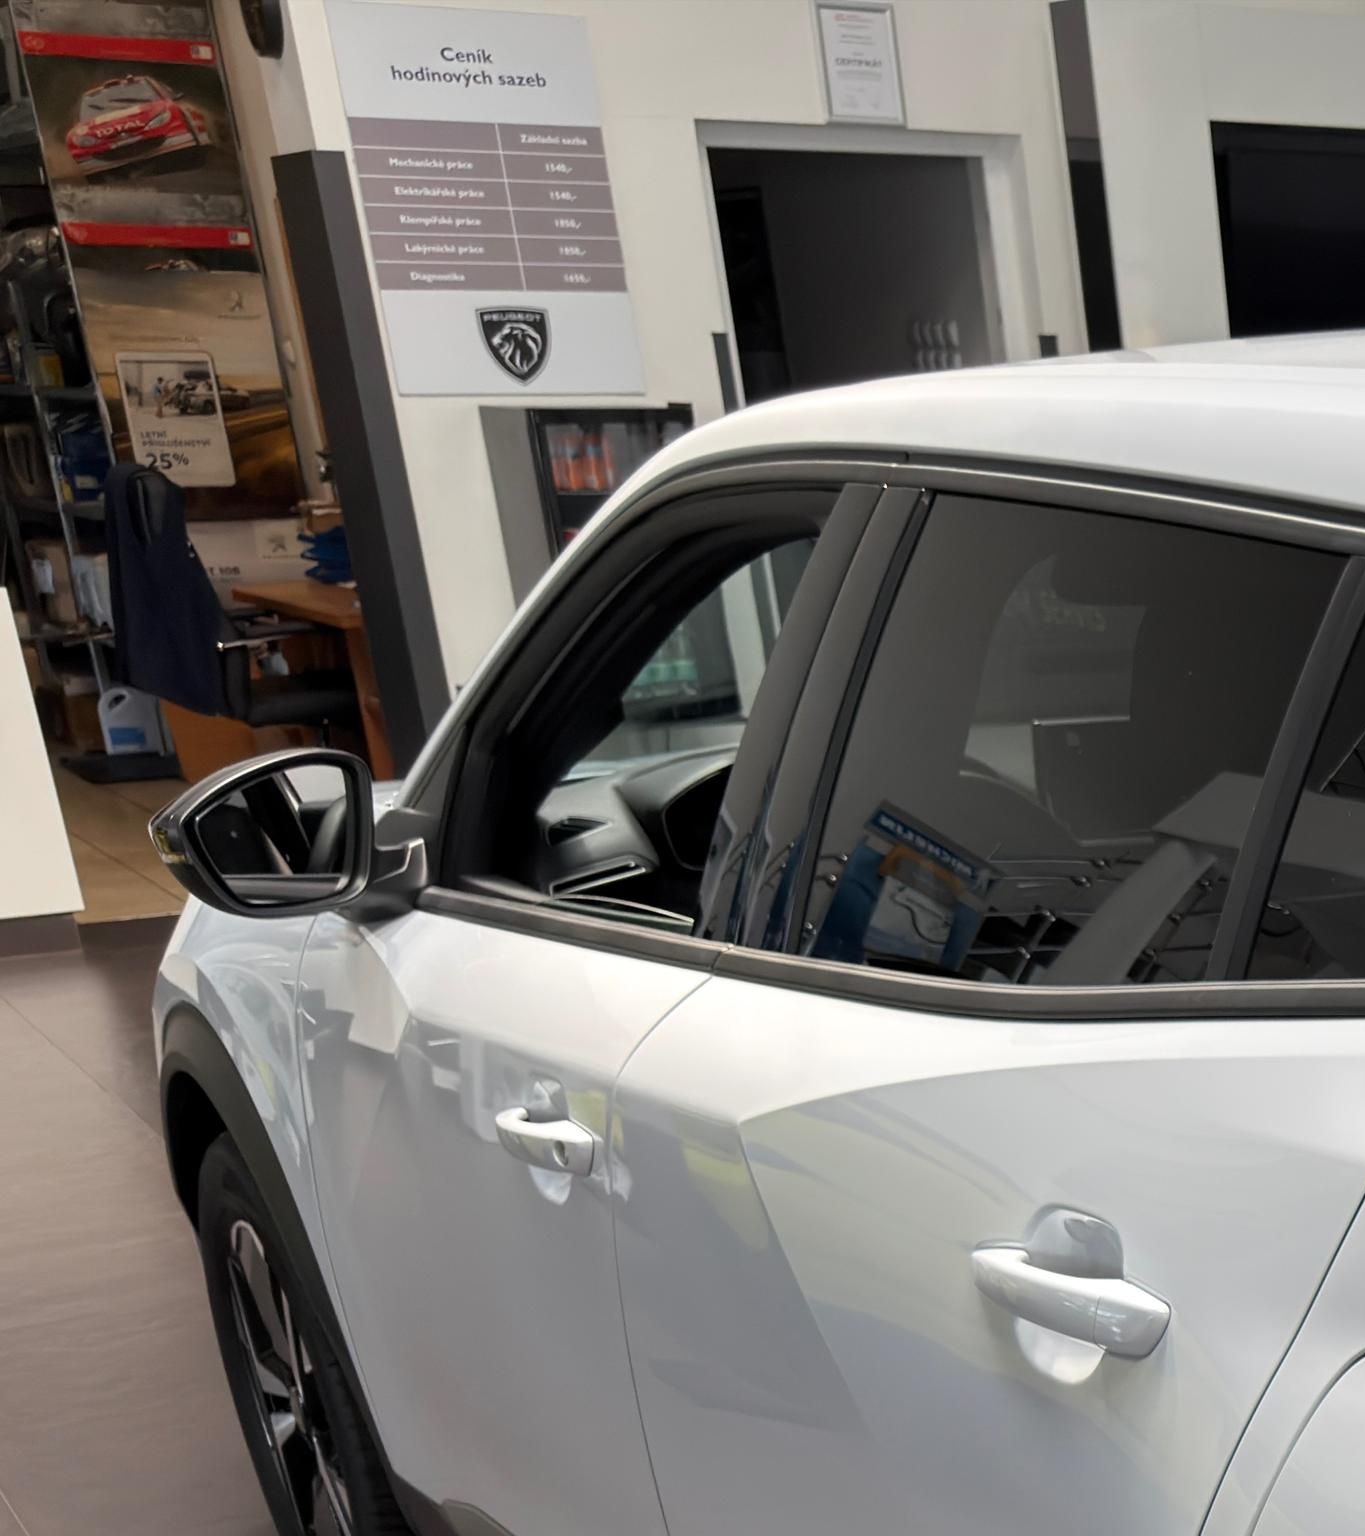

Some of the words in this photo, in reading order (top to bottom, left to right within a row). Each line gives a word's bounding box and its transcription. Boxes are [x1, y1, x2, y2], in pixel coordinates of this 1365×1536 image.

[440, 46, 493, 65] Ceník
[390, 65, 493, 88] hodinových
[498, 73, 547, 88] sazeb
